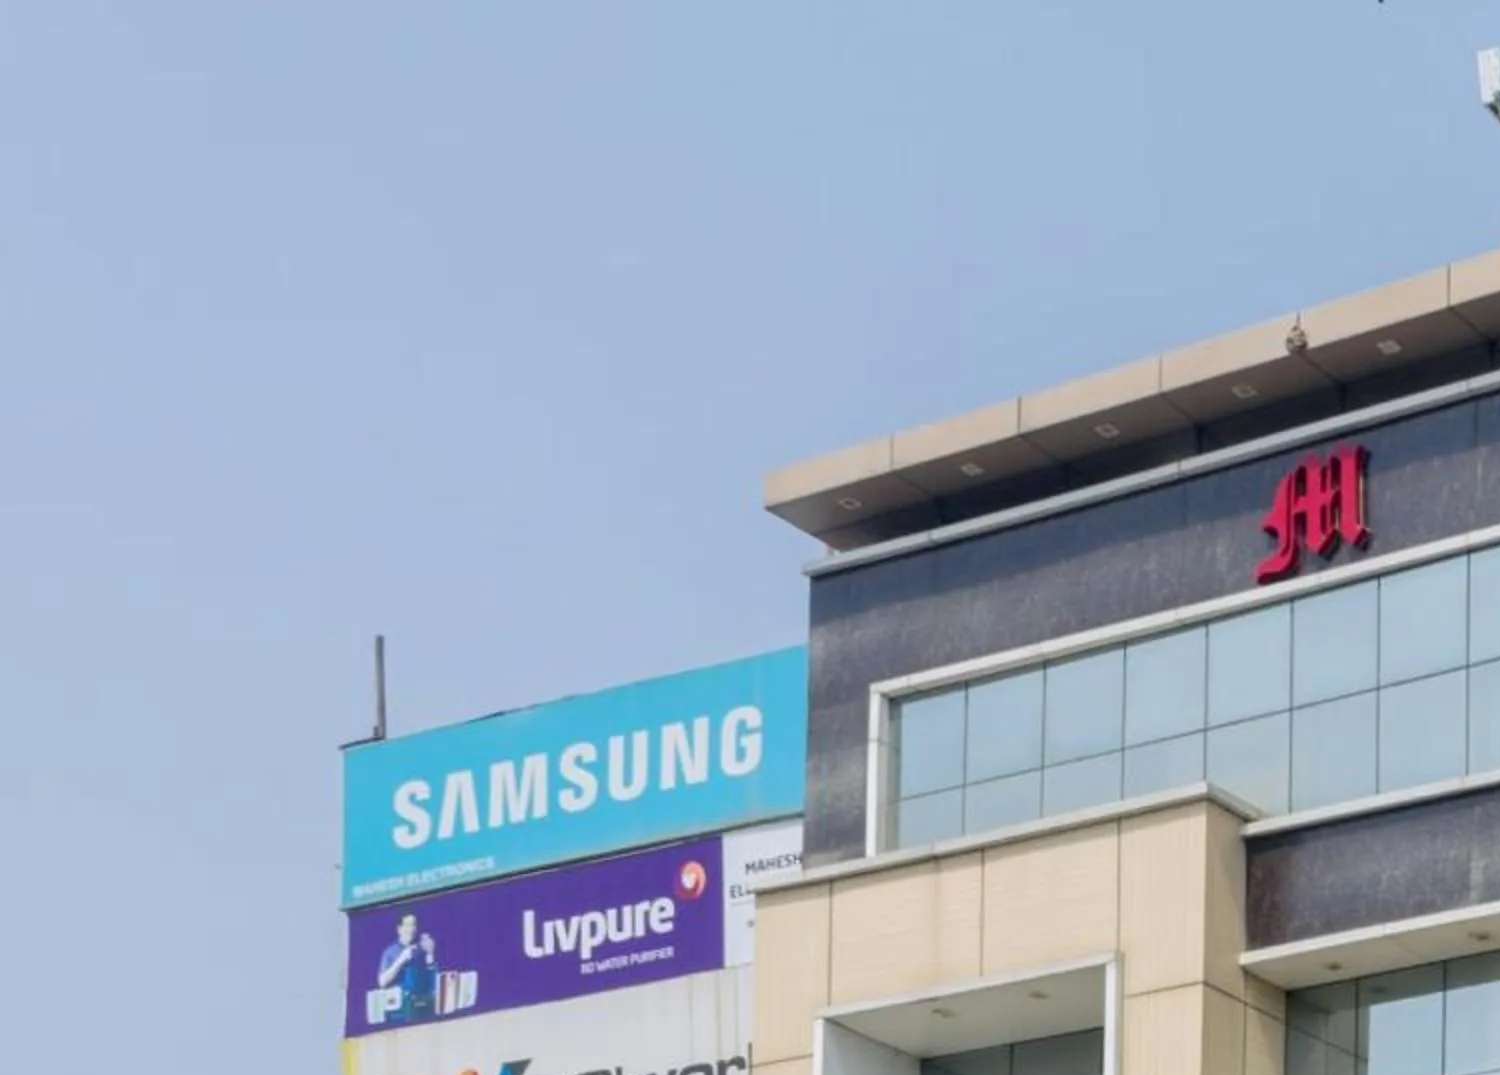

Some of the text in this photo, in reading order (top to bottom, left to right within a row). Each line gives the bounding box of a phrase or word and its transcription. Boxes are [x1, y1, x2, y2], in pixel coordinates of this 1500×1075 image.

[392, 705, 764, 849] SAMSUNG
[522, 897, 675, 960] Livpure
[596, 956, 629, 973] WATER
